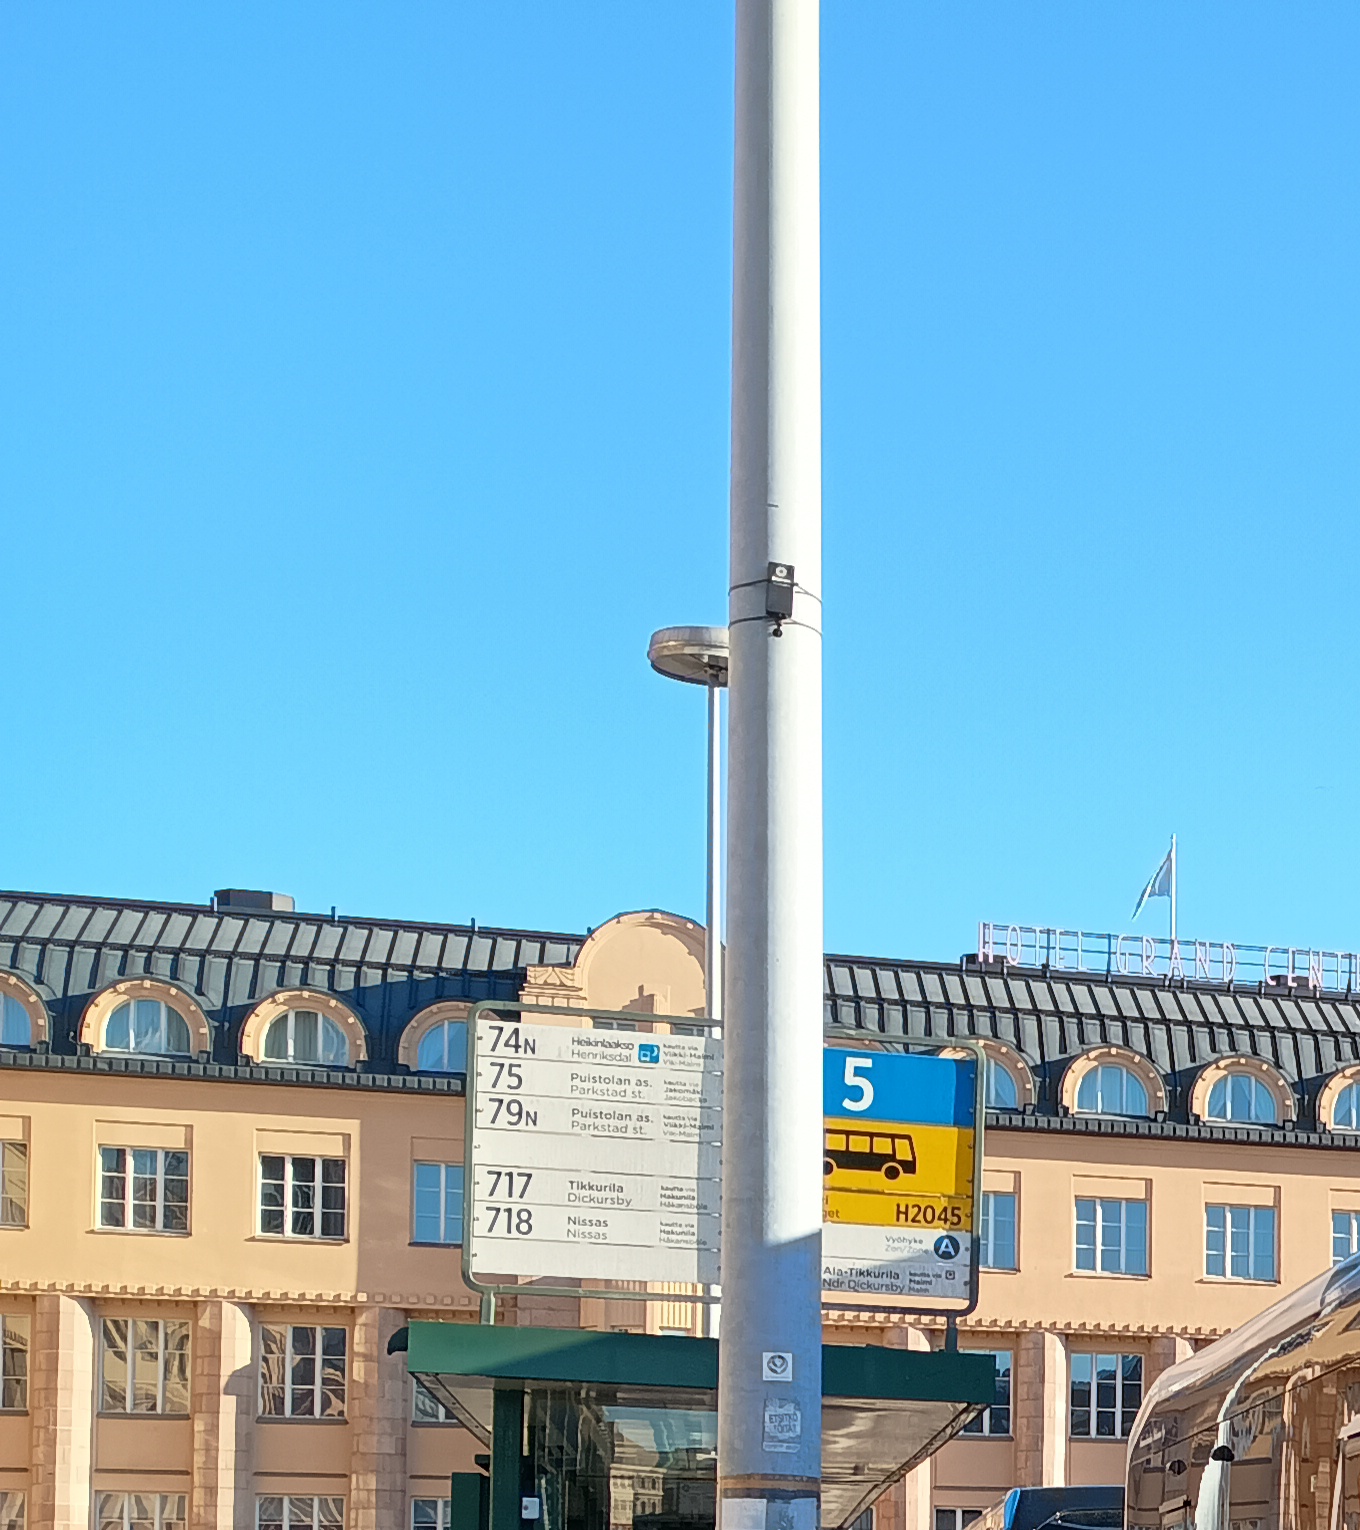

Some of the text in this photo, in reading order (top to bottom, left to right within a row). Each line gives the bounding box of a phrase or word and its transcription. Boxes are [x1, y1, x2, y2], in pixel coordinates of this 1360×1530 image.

[978, 921, 1087, 971] HOTEL
[1116, 933, 1236, 982] GRAND
[489, 1026, 535, 1055] 74N
[571, 1037, 634, 1050] Heikinlaakso
[571, 1049, 632, 1062] Henriksdal
[490, 1062, 522, 1090] 75
[571, 1073, 653, 1088] Puistolan as.
[842, 1057, 873, 1111] 5
[570, 1085, 645, 1099] Parkstad st.
[489, 1098, 537, 1127] 79N
[572, 1108, 654, 1123] Puistolan as.
[571, 1121, 647, 1135] Parkstad st.
[487, 1170, 533, 1199] 717
[568, 1180, 624, 1194] Tikkurila
[567, 1192, 632, 1207] Dickursby
[486, 1206, 533, 1236] 718
[567, 1216, 609, 1228] Nissas
[896, 1203, 962, 1226] H2045
[567, 1228, 608, 1240] Nissas
[938, 1238, 955, 1256] A
[823, 1266, 900, 1280] Ala-Tikkurila
[848, 1279, 904, 1293] Dickursby
